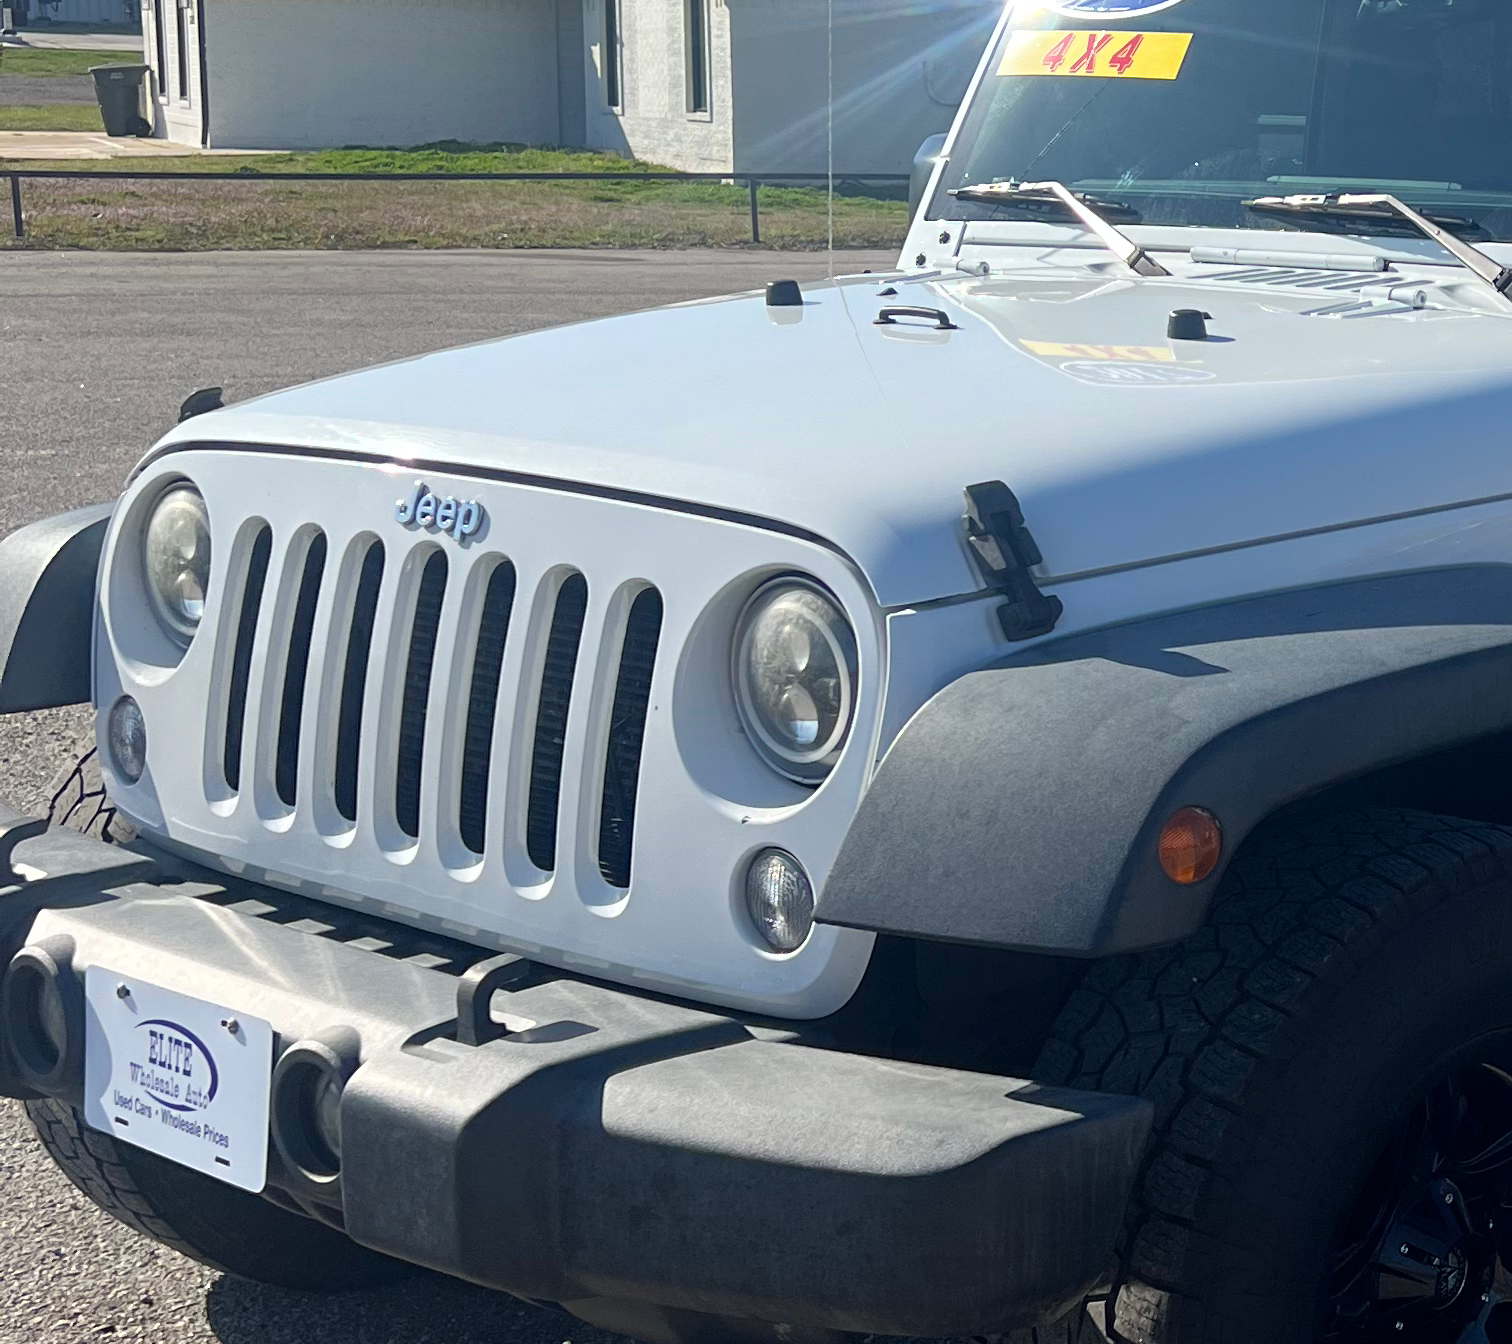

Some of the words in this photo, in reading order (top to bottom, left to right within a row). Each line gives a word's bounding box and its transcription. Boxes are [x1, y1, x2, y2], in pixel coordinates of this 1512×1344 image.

[395, 479, 483, 544] Jeep
[149, 1029, 192, 1077] ELITE
[129, 1061, 179, 1098] Wholesale
[185, 1082, 209, 1109] Auto
[113, 1088, 133, 1111] Used
[134, 1097, 152, 1119] Cars
[160, 1107, 201, 1138] Wholesale
[203, 1123, 229, 1149] Prices
